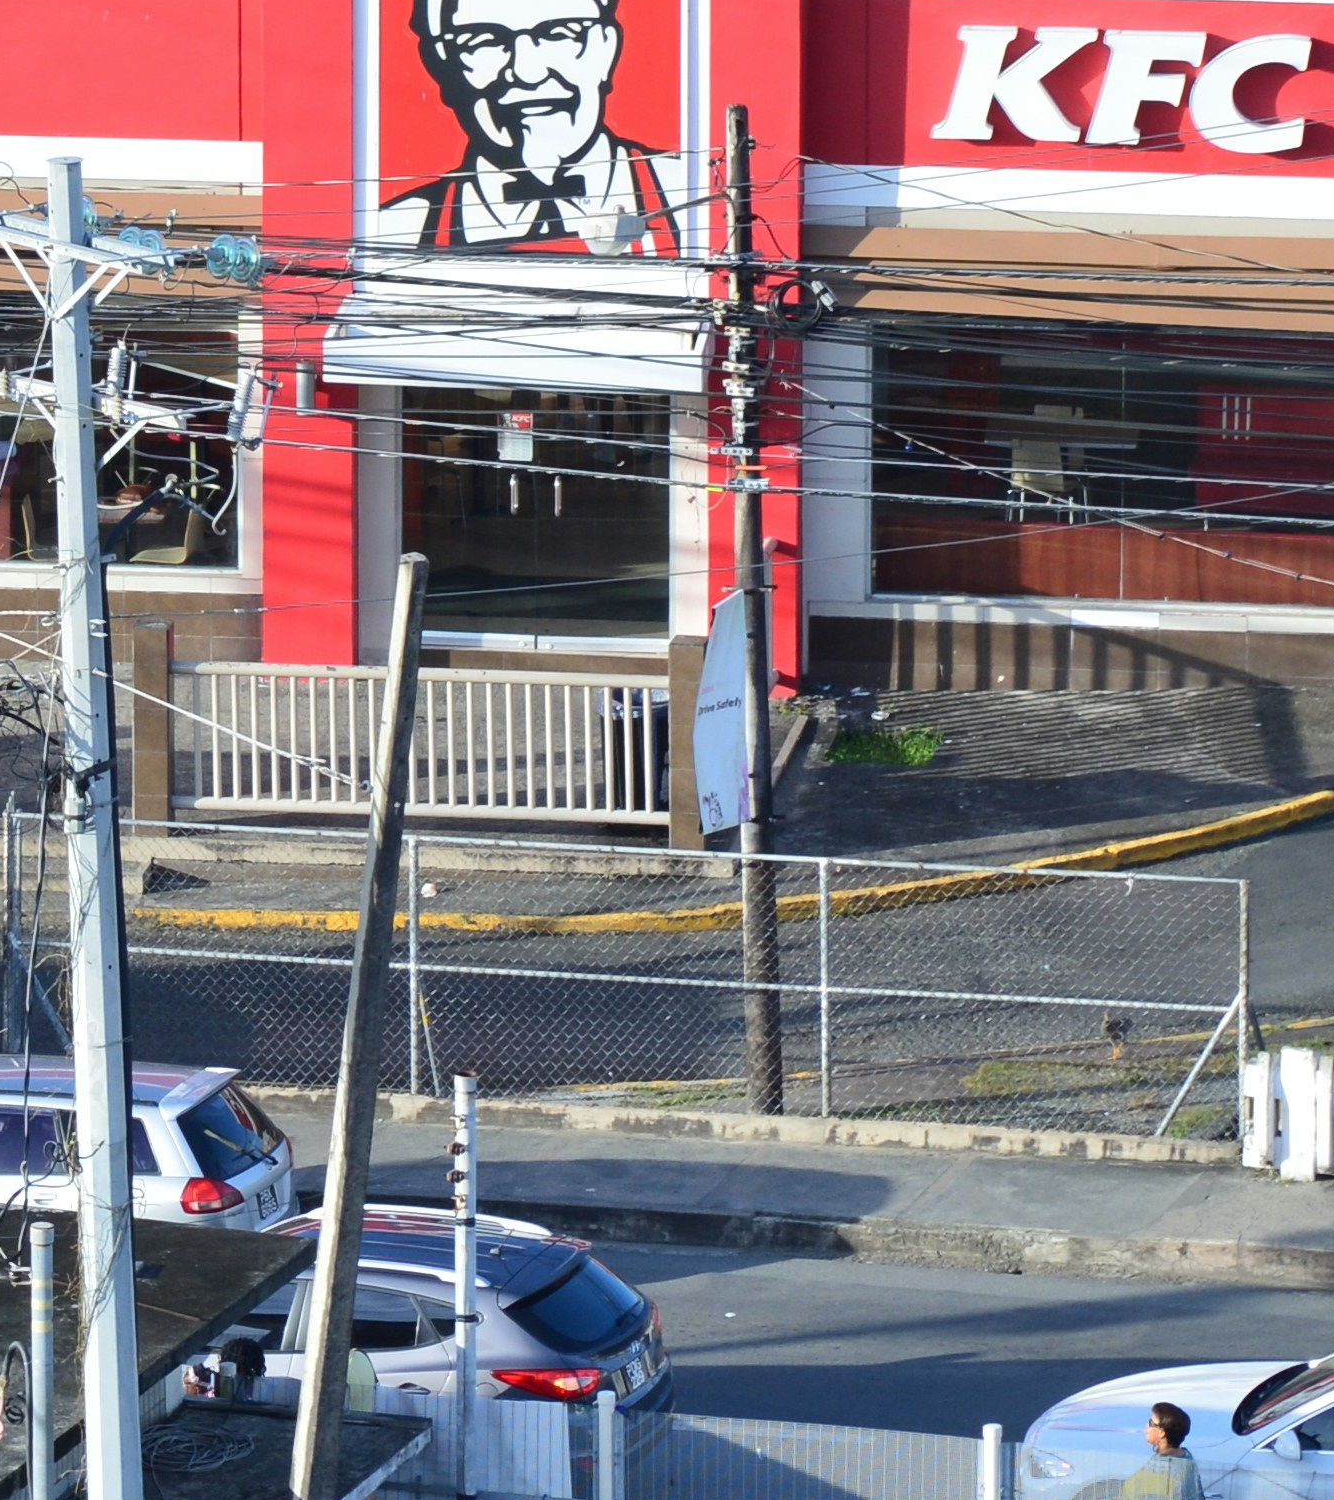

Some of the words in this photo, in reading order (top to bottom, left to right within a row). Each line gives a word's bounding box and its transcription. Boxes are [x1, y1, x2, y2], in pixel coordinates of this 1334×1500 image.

[929, 25, 1313, 154] KFC
[697, 701, 716, 717] Drive
[716, 697, 742, 712] Safely
